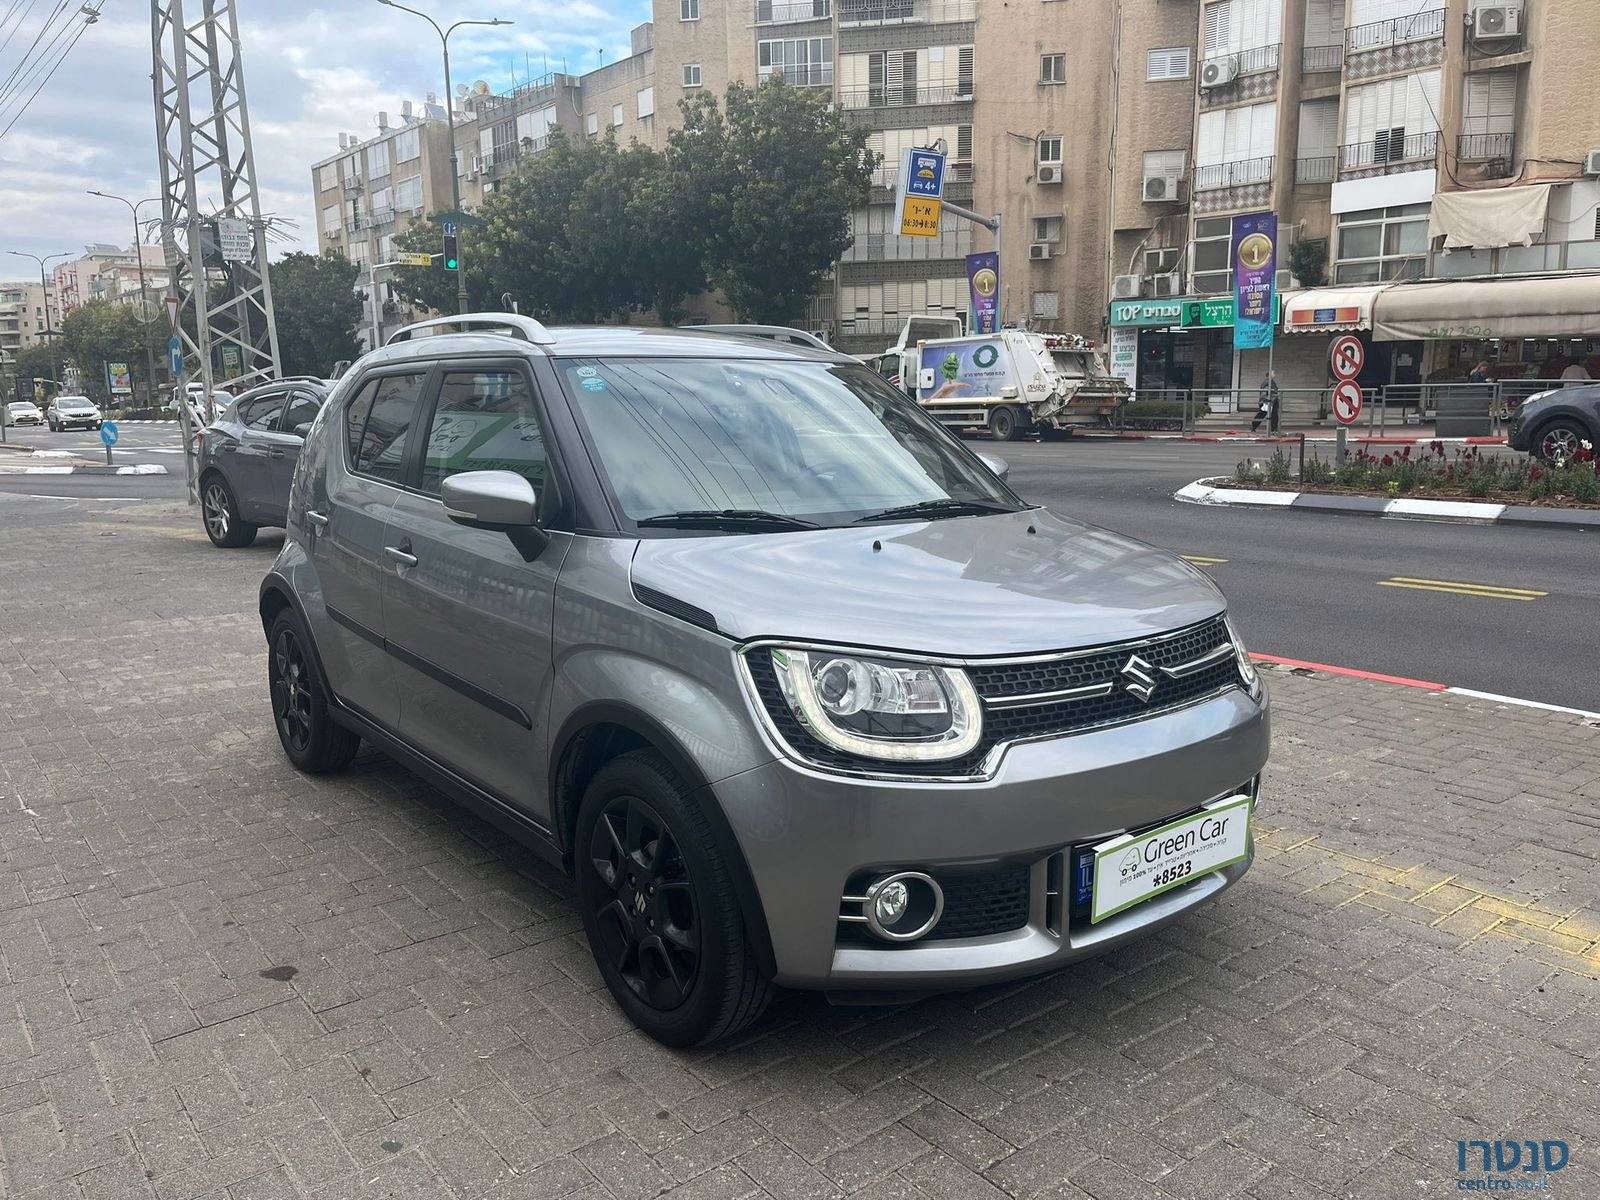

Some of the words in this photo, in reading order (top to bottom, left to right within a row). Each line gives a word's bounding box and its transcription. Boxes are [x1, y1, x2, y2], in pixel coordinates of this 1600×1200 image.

[1115, 305, 1142, 321] TOP
[1143, 305, 1181, 319] טבחים
[1144, 829, 1195, 864] Green
[1199, 817, 1229, 841] Car
